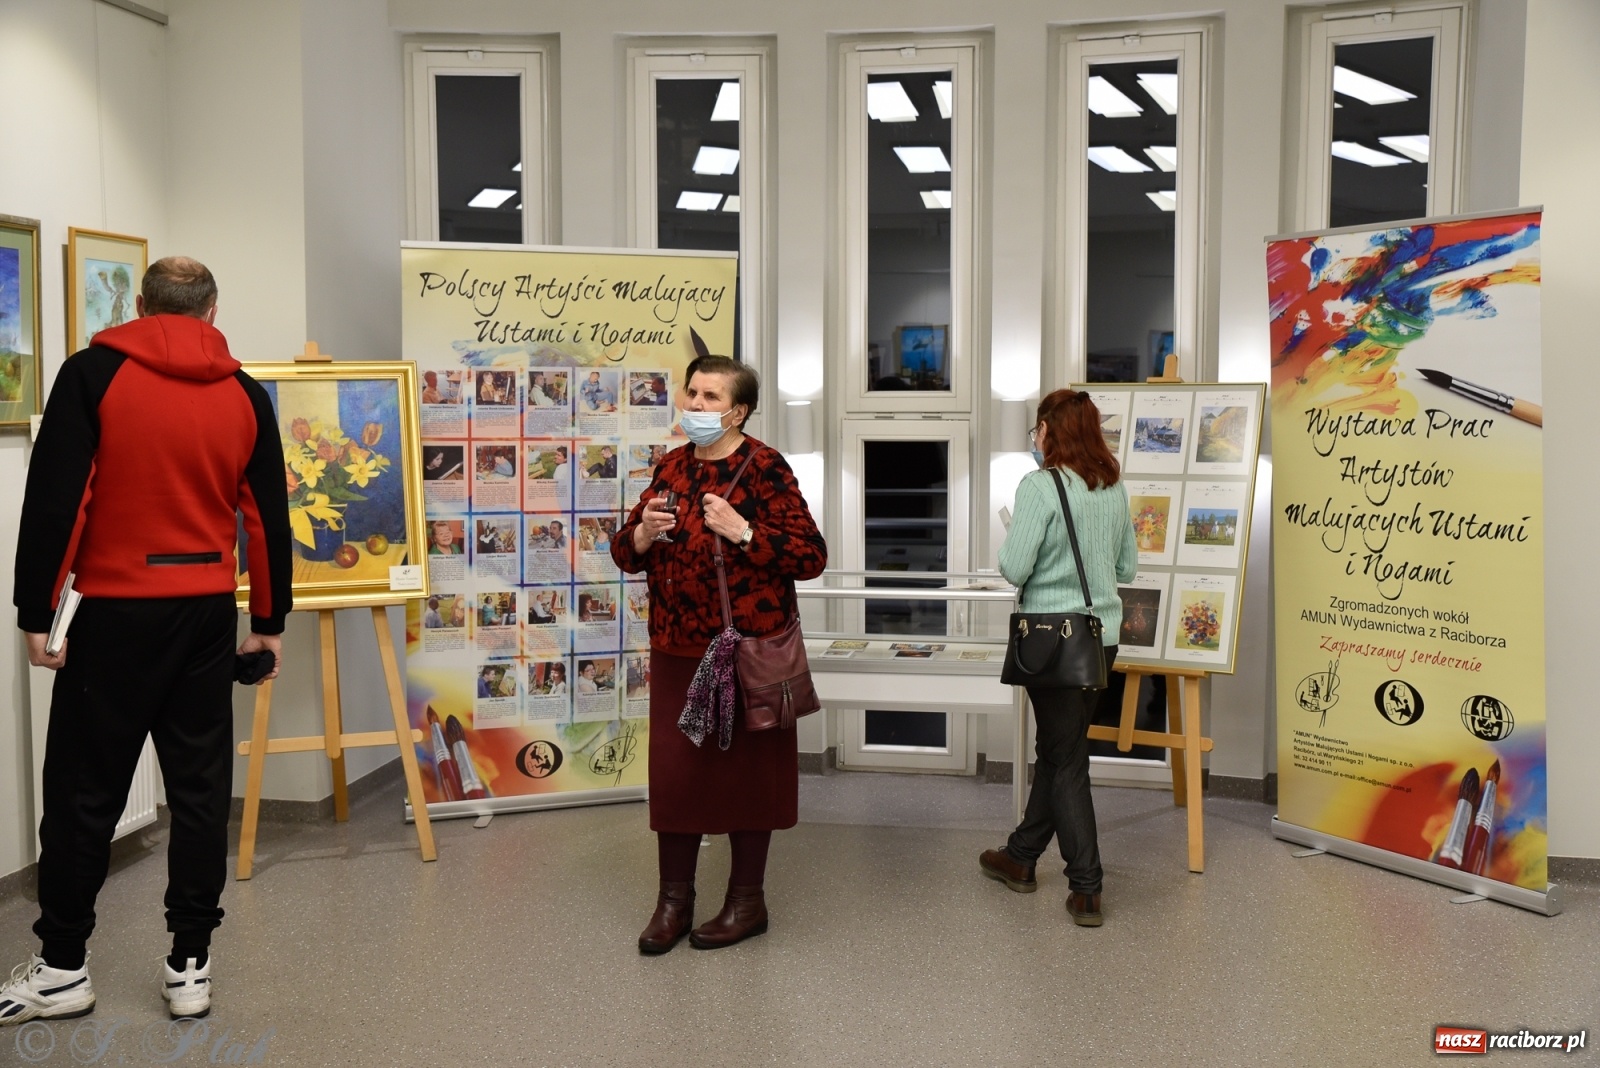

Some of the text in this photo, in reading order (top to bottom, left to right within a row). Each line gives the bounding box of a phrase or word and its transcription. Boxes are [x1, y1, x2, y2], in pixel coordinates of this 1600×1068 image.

[420, 269, 507, 317] Polscy
[515, 274, 607, 318] Artyści
[474, 319, 679, 362] Ustami i Nogami
[1305, 407, 1494, 457] Wystawa Prac
[1340, 455, 1455, 506] Artystów
[1428, 510, 1532, 542] Ustami
[1345, 552, 1456, 600] i Nogami
[1300, 609, 1507, 649] AMUN Wydawnictwa z Raciborza
[1329, 596, 1470, 625] Zgromadzonych wokół
[1319, 635, 1482, 673] Zapraszamy serdecznie
[1313, 734, 1349, 746] Wydawnictwo
[1345, 749, 1364, 758] Ustami
[1368, 753, 1389, 763] Nogami
